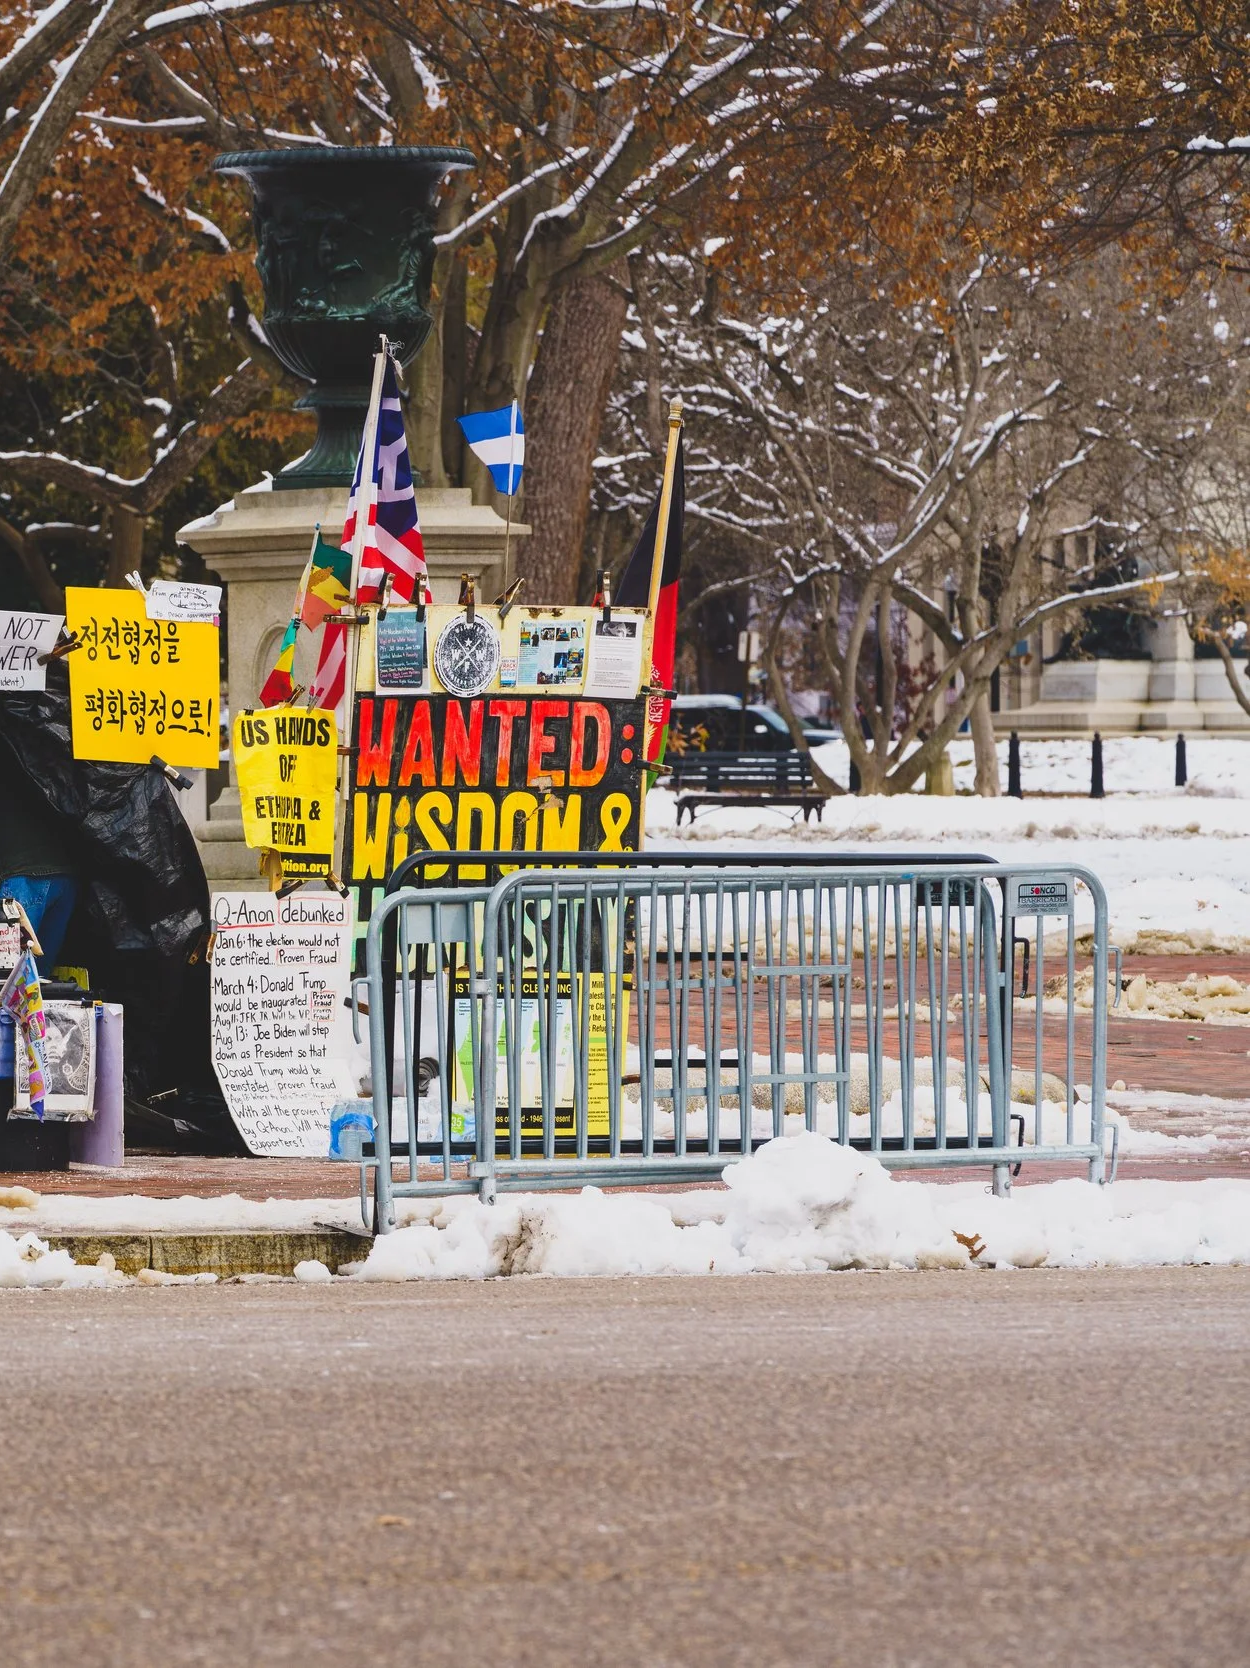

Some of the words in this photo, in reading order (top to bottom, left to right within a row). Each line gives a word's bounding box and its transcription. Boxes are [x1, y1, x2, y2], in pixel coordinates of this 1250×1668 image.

[4, 616, 51, 641] NOT
[79, 617, 180, 665] 정전협정을
[84, 687, 212, 738] 평화협정으로!
[241, 719, 270, 748] US
[275, 717, 331, 747] HANDS
[309, 800, 321, 821] &
[598, 793, 634, 872] &
[1030, 886, 1056, 895] SONCO
[214, 897, 275, 926] Q-Anon
[281, 896, 344, 923] debunked
[247, 933, 263, 948] the
[266, 932, 295, 947] election
[298, 933, 323, 947] would
[325, 932, 341, 947] not
[215, 951, 226, 967] be
[278, 948, 305, 964] Proven
[309, 949, 337, 964] Fraud
[260, 974, 294, 994] Donald
[299, 971, 327, 990] Trump
[214, 999, 242, 1013] would
[248, 997, 258, 1011] be
[261, 993, 307, 1009] inaugurated
[312, 992, 335, 1000] Proven
[239, 1012, 257, 1024] JFK
[253, 1024, 270, 1041] Joe
[273, 1023, 297, 1040] Biden
[298, 1024, 310, 1037] will
[312, 1021, 329, 1039] step
[215, 1048, 237, 1061] down
[240, 1049, 251, 1059] as
[254, 1044, 294, 1060] President
[297, 1048, 307, 1058] so
[309, 1044, 327, 1058] that
[217, 1062, 254, 1079] Donald
[254, 1062, 283, 1077] Trump
[287, 1065, 308, 1076] would
[312, 1064, 322, 1075] be
[277, 1079, 305, 1093] proven
[310, 1077, 336, 1090] fraud
[232, 1104, 259, 1119] With
[262, 1103, 273, 1114] all
[274, 1103, 290, 1116] the
[291, 1107, 318, 1120] proven
[240, 1122, 255, 1138] by
[293, 1119, 310, 1132] Will
[250, 1134, 304, 1151] supporters?
